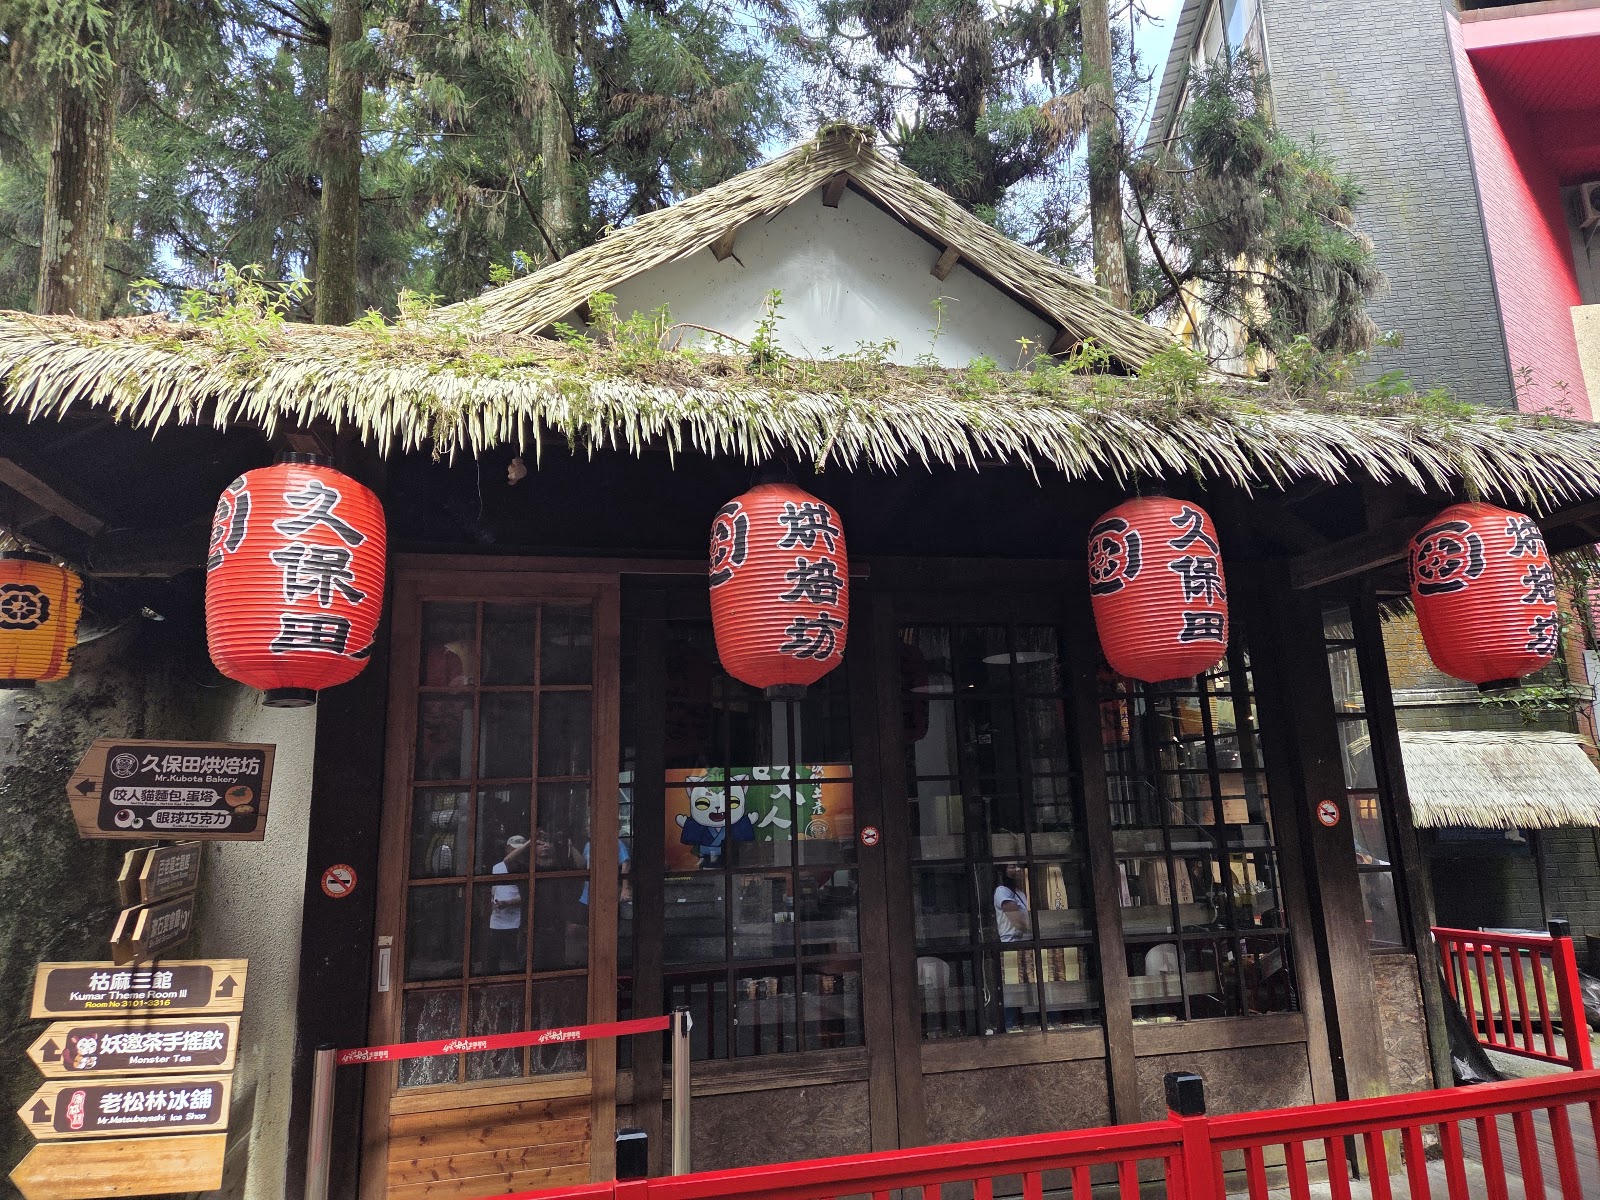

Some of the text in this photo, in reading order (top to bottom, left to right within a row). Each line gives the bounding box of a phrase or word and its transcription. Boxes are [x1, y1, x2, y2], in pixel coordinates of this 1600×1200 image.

[269, 479, 368, 655] 久保田
[1167, 505, 1228, 643] 久保田
[775, 501, 845, 661] 烘焙坊
[140, 754, 260, 775] 久保田烘焙坊
[155, 774, 238, 784] Mr.Kubota Bakery
[156, 812, 227, 825] 眼球巧克力
[89, 971, 173, 991] 枯麻三館
[69, 991, 106, 1000] Kumar
[108, 991, 146, 1000] Theme
[147, 990, 176, 999] Room
[100, 1030, 224, 1055] 妖邀茶手搖飲
[129, 1055, 192, 1065] Monster Tea
[99, 1088, 213, 1114] 老松林冰舖
[169, 1113, 183, 1121] Ice
[185, 1112, 207, 1121] Shop
